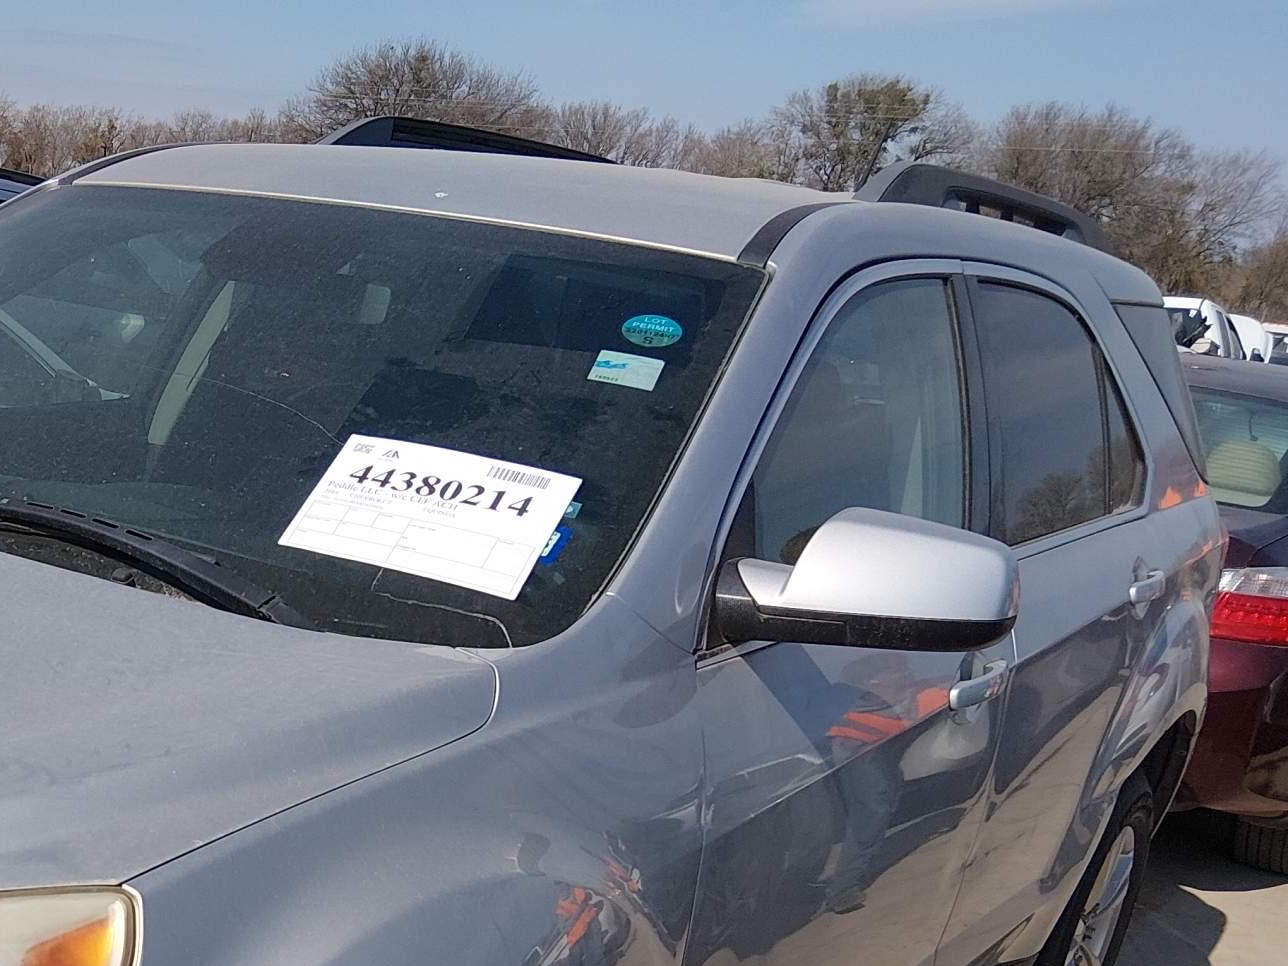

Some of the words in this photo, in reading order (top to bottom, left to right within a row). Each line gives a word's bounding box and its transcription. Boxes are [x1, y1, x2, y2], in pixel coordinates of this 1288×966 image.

[643, 316, 666, 325] LOT
[632, 321, 674, 333] PERMIT
[349, 464, 534, 517] 44380214
